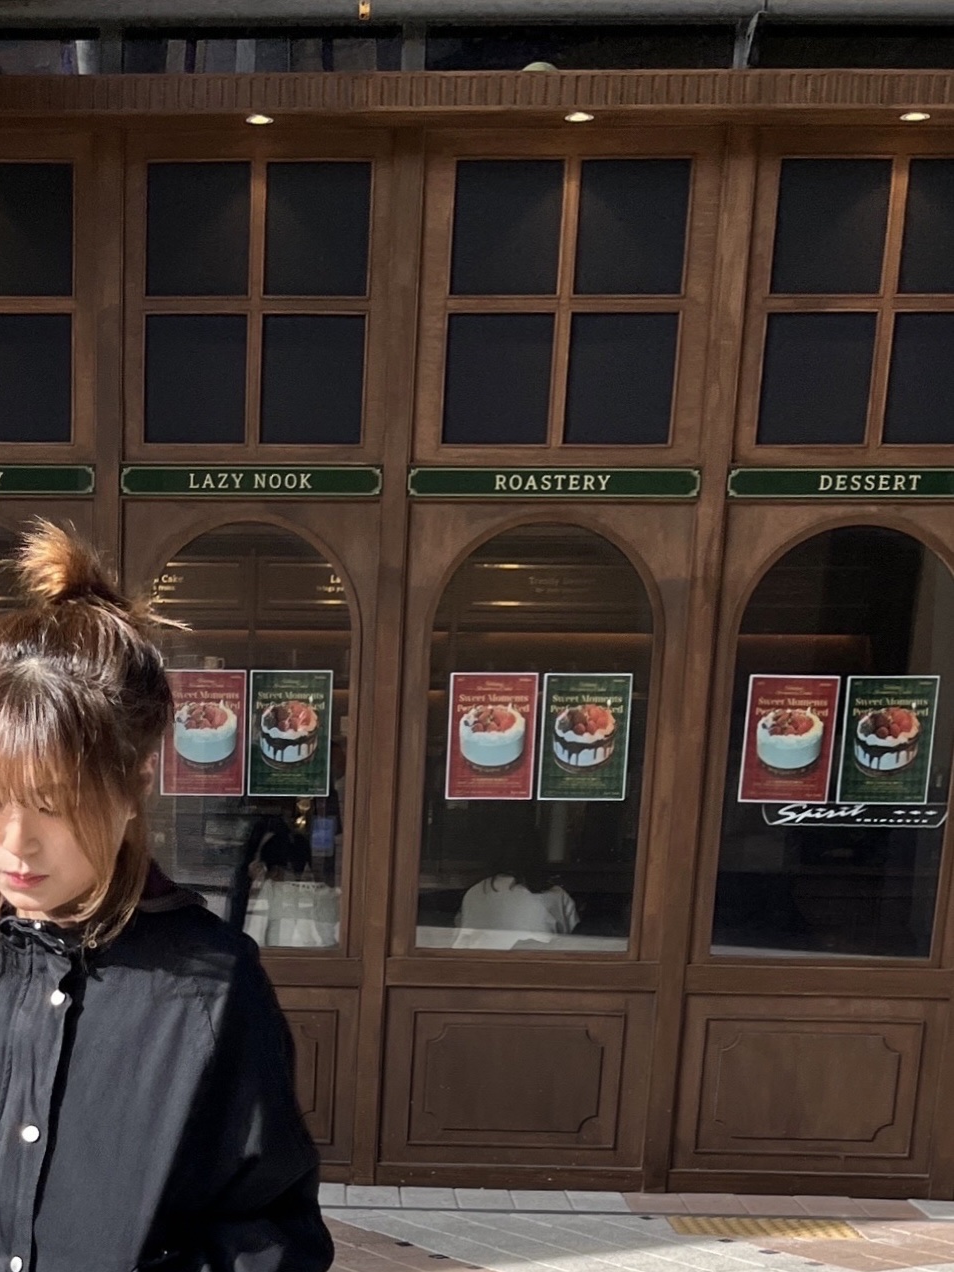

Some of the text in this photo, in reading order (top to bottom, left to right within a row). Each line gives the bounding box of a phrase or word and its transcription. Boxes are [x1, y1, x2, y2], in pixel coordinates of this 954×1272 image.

[188, 473, 313, 489] LAZY NOOK
[494, 474, 611, 491] ROASTERY
[818, 474, 922, 491] DESSERT
[458, 693, 529, 702] Sweet Moments
